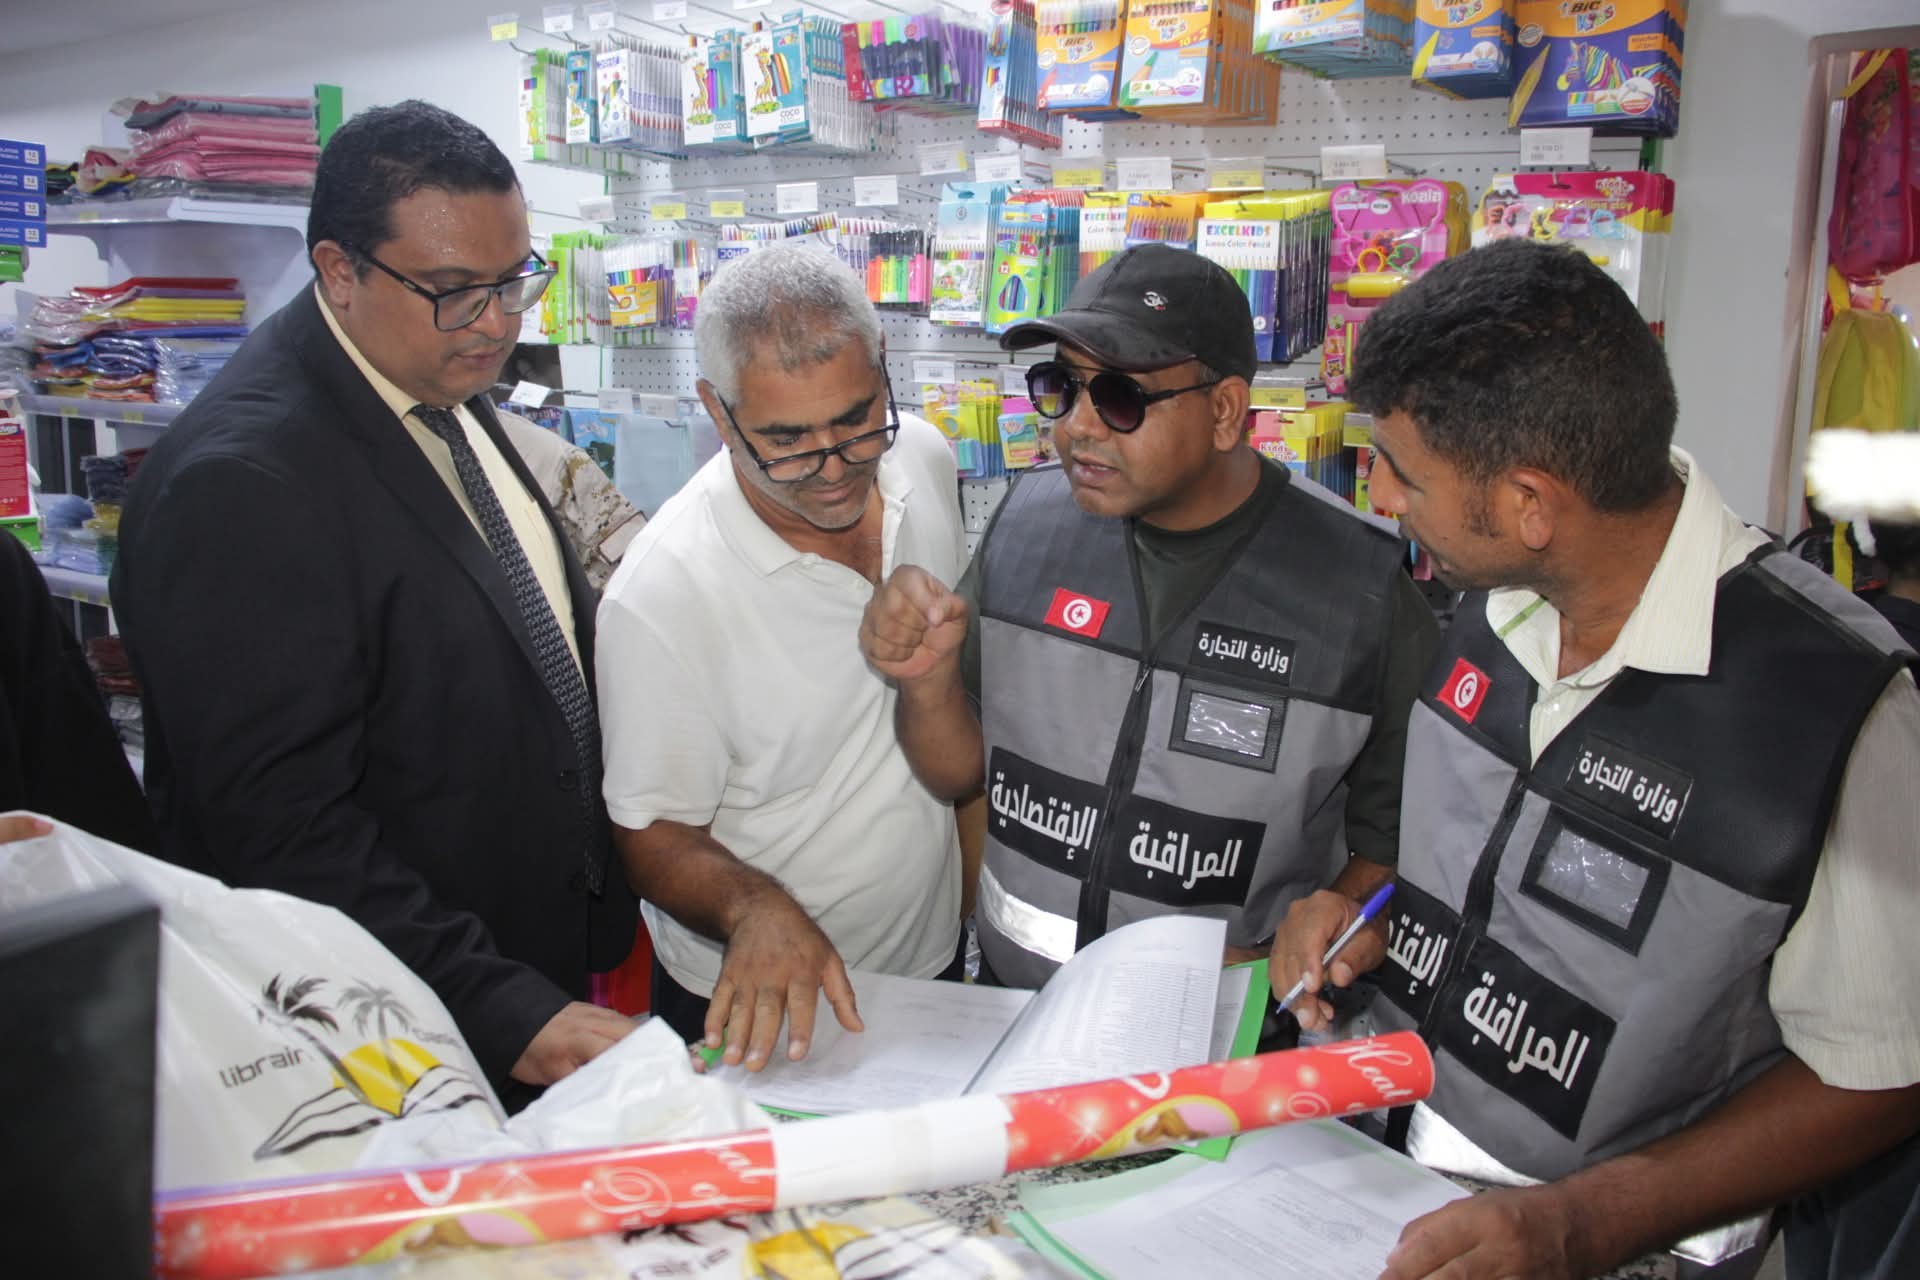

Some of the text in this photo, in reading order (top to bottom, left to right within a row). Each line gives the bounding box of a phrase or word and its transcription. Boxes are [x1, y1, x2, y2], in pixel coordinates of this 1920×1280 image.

[1206, 225, 1271, 236] EXCELKIDS
[1198, 632, 1289, 674] وزارة التجارة
[1579, 749, 1679, 823] وزارة التجارة
[991, 771, 1242, 889] المراقبة الإقتصادية
[1463, 971, 1591, 1090] المراقبة
